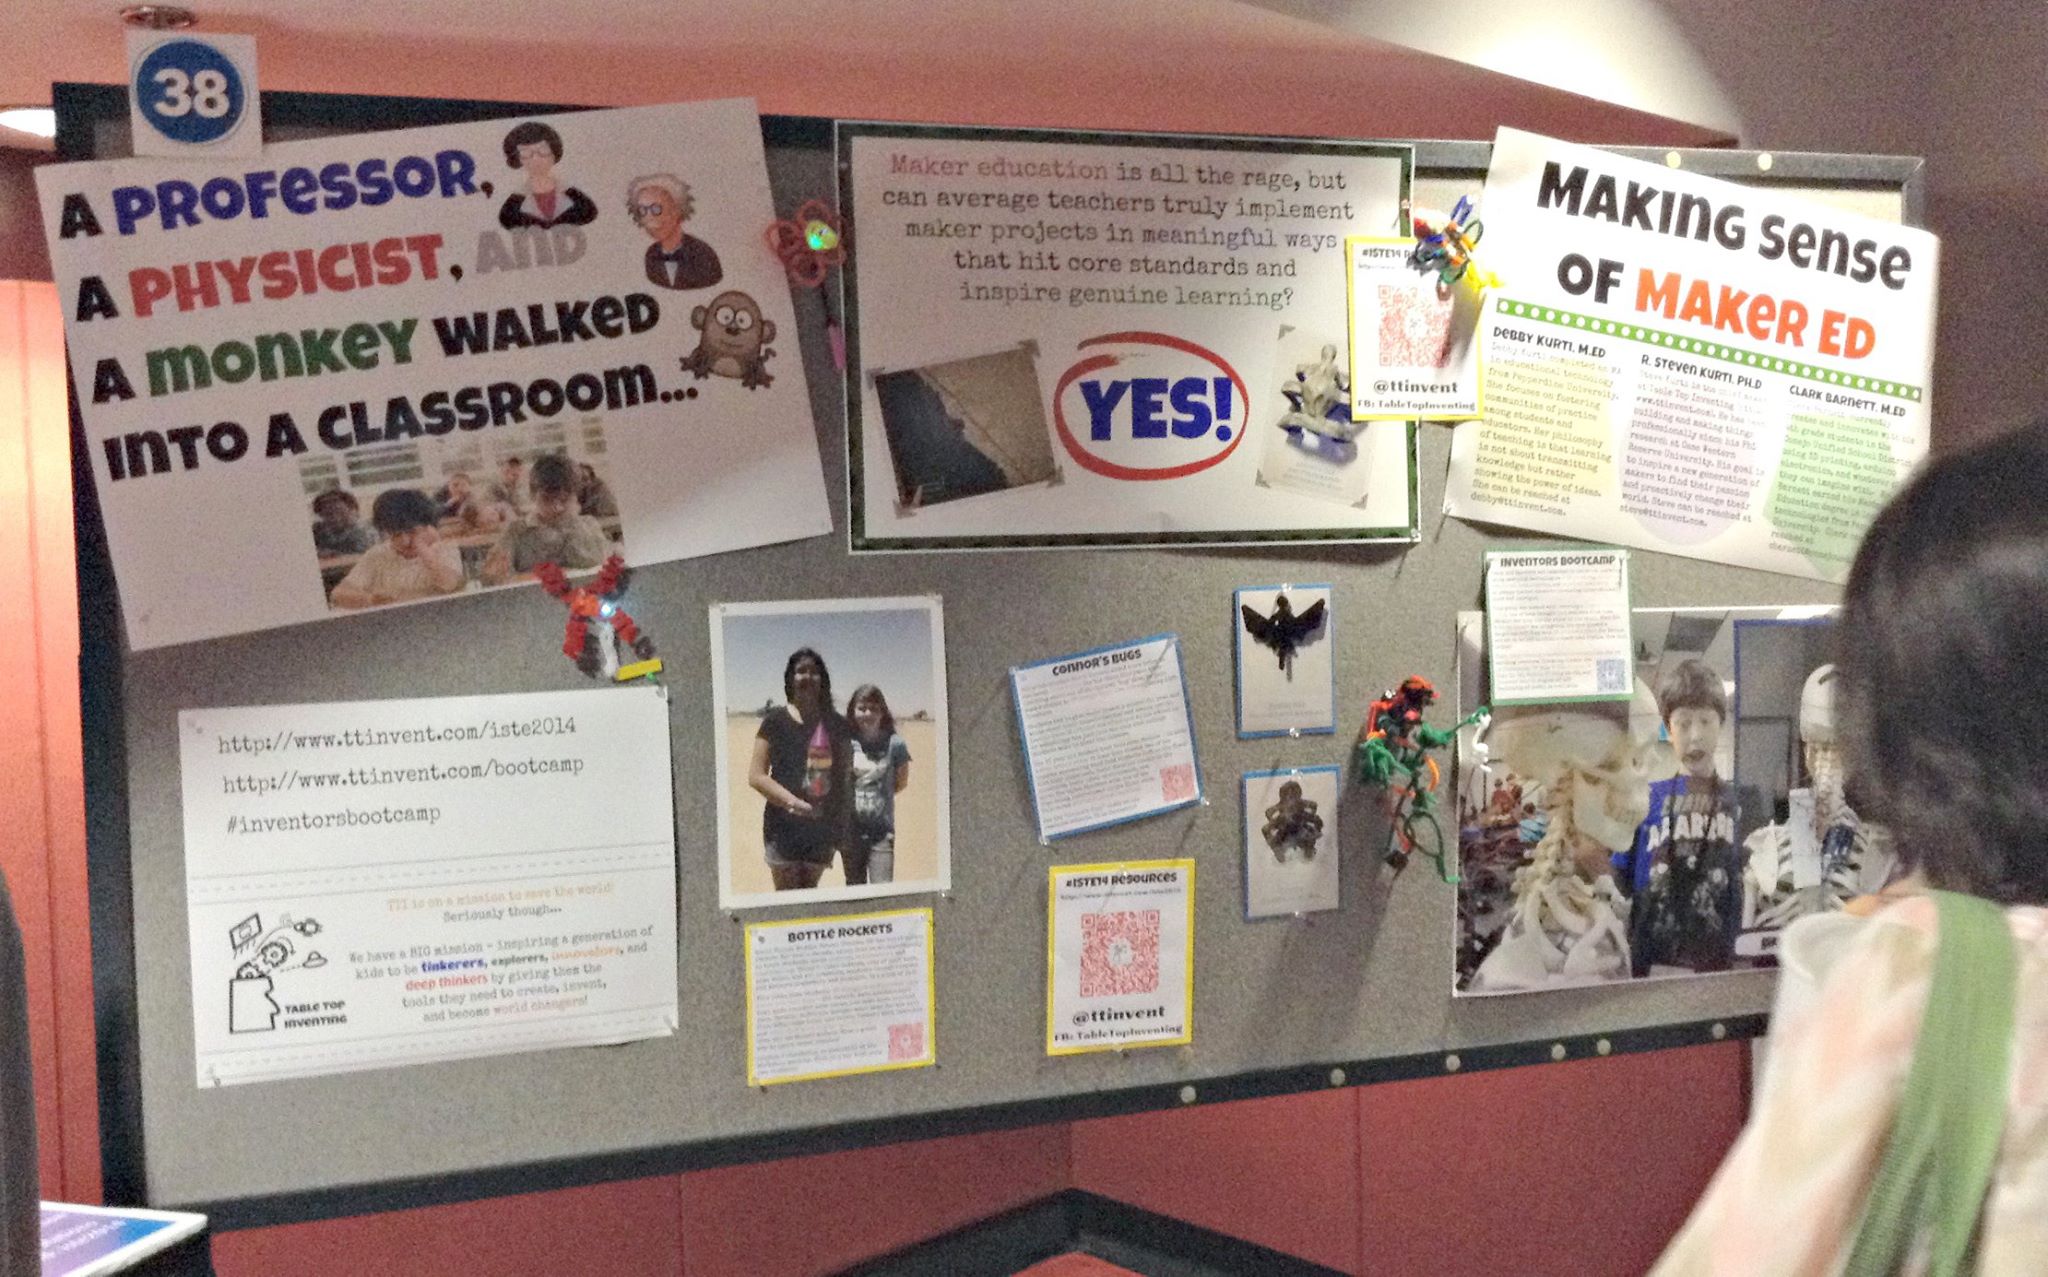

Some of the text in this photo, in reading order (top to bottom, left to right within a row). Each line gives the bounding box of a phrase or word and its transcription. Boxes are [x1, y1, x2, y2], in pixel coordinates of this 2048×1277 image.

[153, 70, 230, 118] 38
[891, 154, 1345, 192] Maker education is all the rage, but
[59, 194, 102, 238] A
[883, 187, 1354, 223] can average teachers truly implement
[906, 217, 1336, 253] maker projects in meaningful ways
[75, 278, 119, 321] A
[128, 234, 462, 317] PHYSICIST,
[955, 250, 1296, 277] that hit core standards and
[960, 281, 1294, 311] inspire genuine learning?
[1557, 252, 1624, 303] OF
[1817, 309, 1876, 360] ED
[91, 359, 135, 403] A
[1374, 378, 1458, 394] @ttinvent
[1789, 384, 1823, 400] CLARK
[1079, 377, 1232, 442] YES!
[265, 413, 307, 458] A
[1112, 648, 1142, 664] BUGS
[219, 716, 576, 755] http://www.ttinvent.com/iste2014
[223, 756, 584, 794] http://www.ttinvent.com/bootcamp
[226, 804, 441, 835] #inventorsbootcamp
[443, 901, 561, 924] Seriously though...
[405, 961, 601, 993] deep thinkers by giving them the
[323, 1001, 345, 1010] TOP
[1073, 1006, 1165, 1026] @ttinvent
